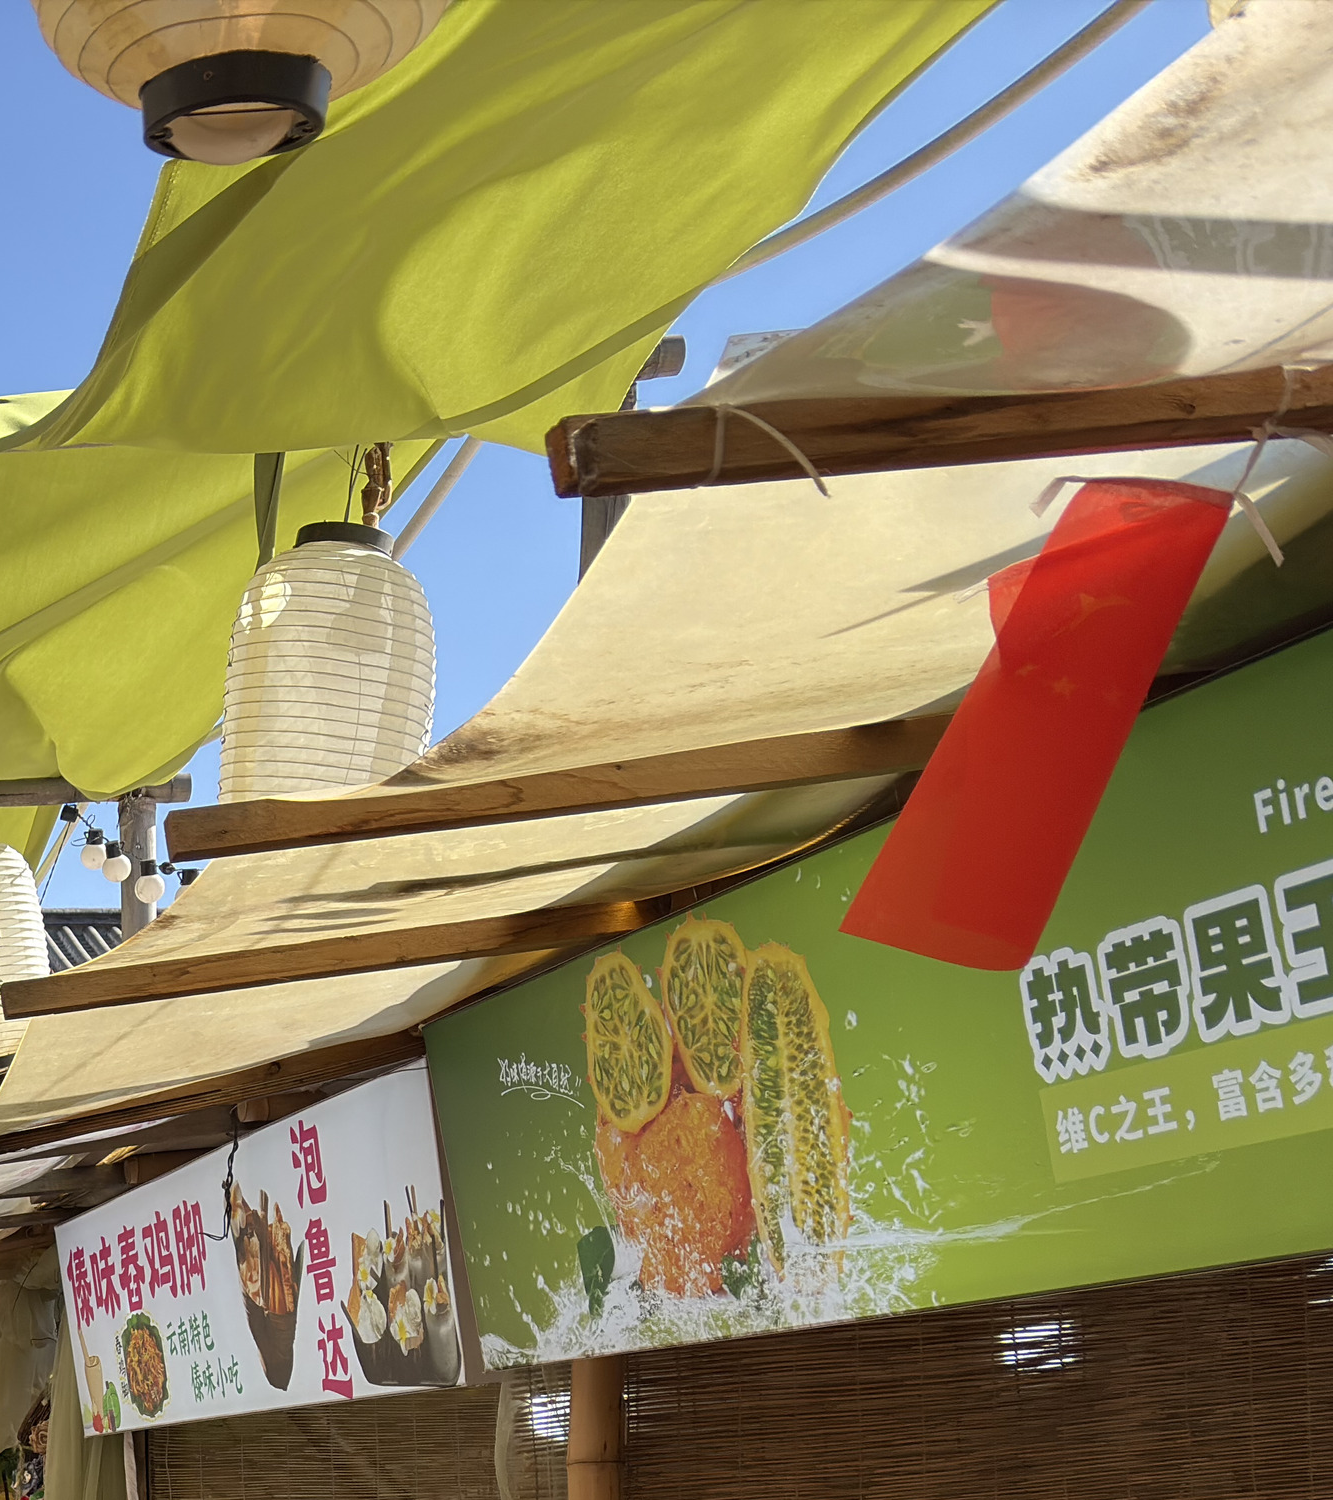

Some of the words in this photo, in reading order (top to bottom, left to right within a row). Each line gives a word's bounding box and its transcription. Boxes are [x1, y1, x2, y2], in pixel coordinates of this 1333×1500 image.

[1253, 775, 1333, 834] Fire
[290, 1119, 353, 1400] 泡鲁达
[166, 1310, 215, 1356] 云南特色
[190, 1354, 244, 1404] 傣味小吃
